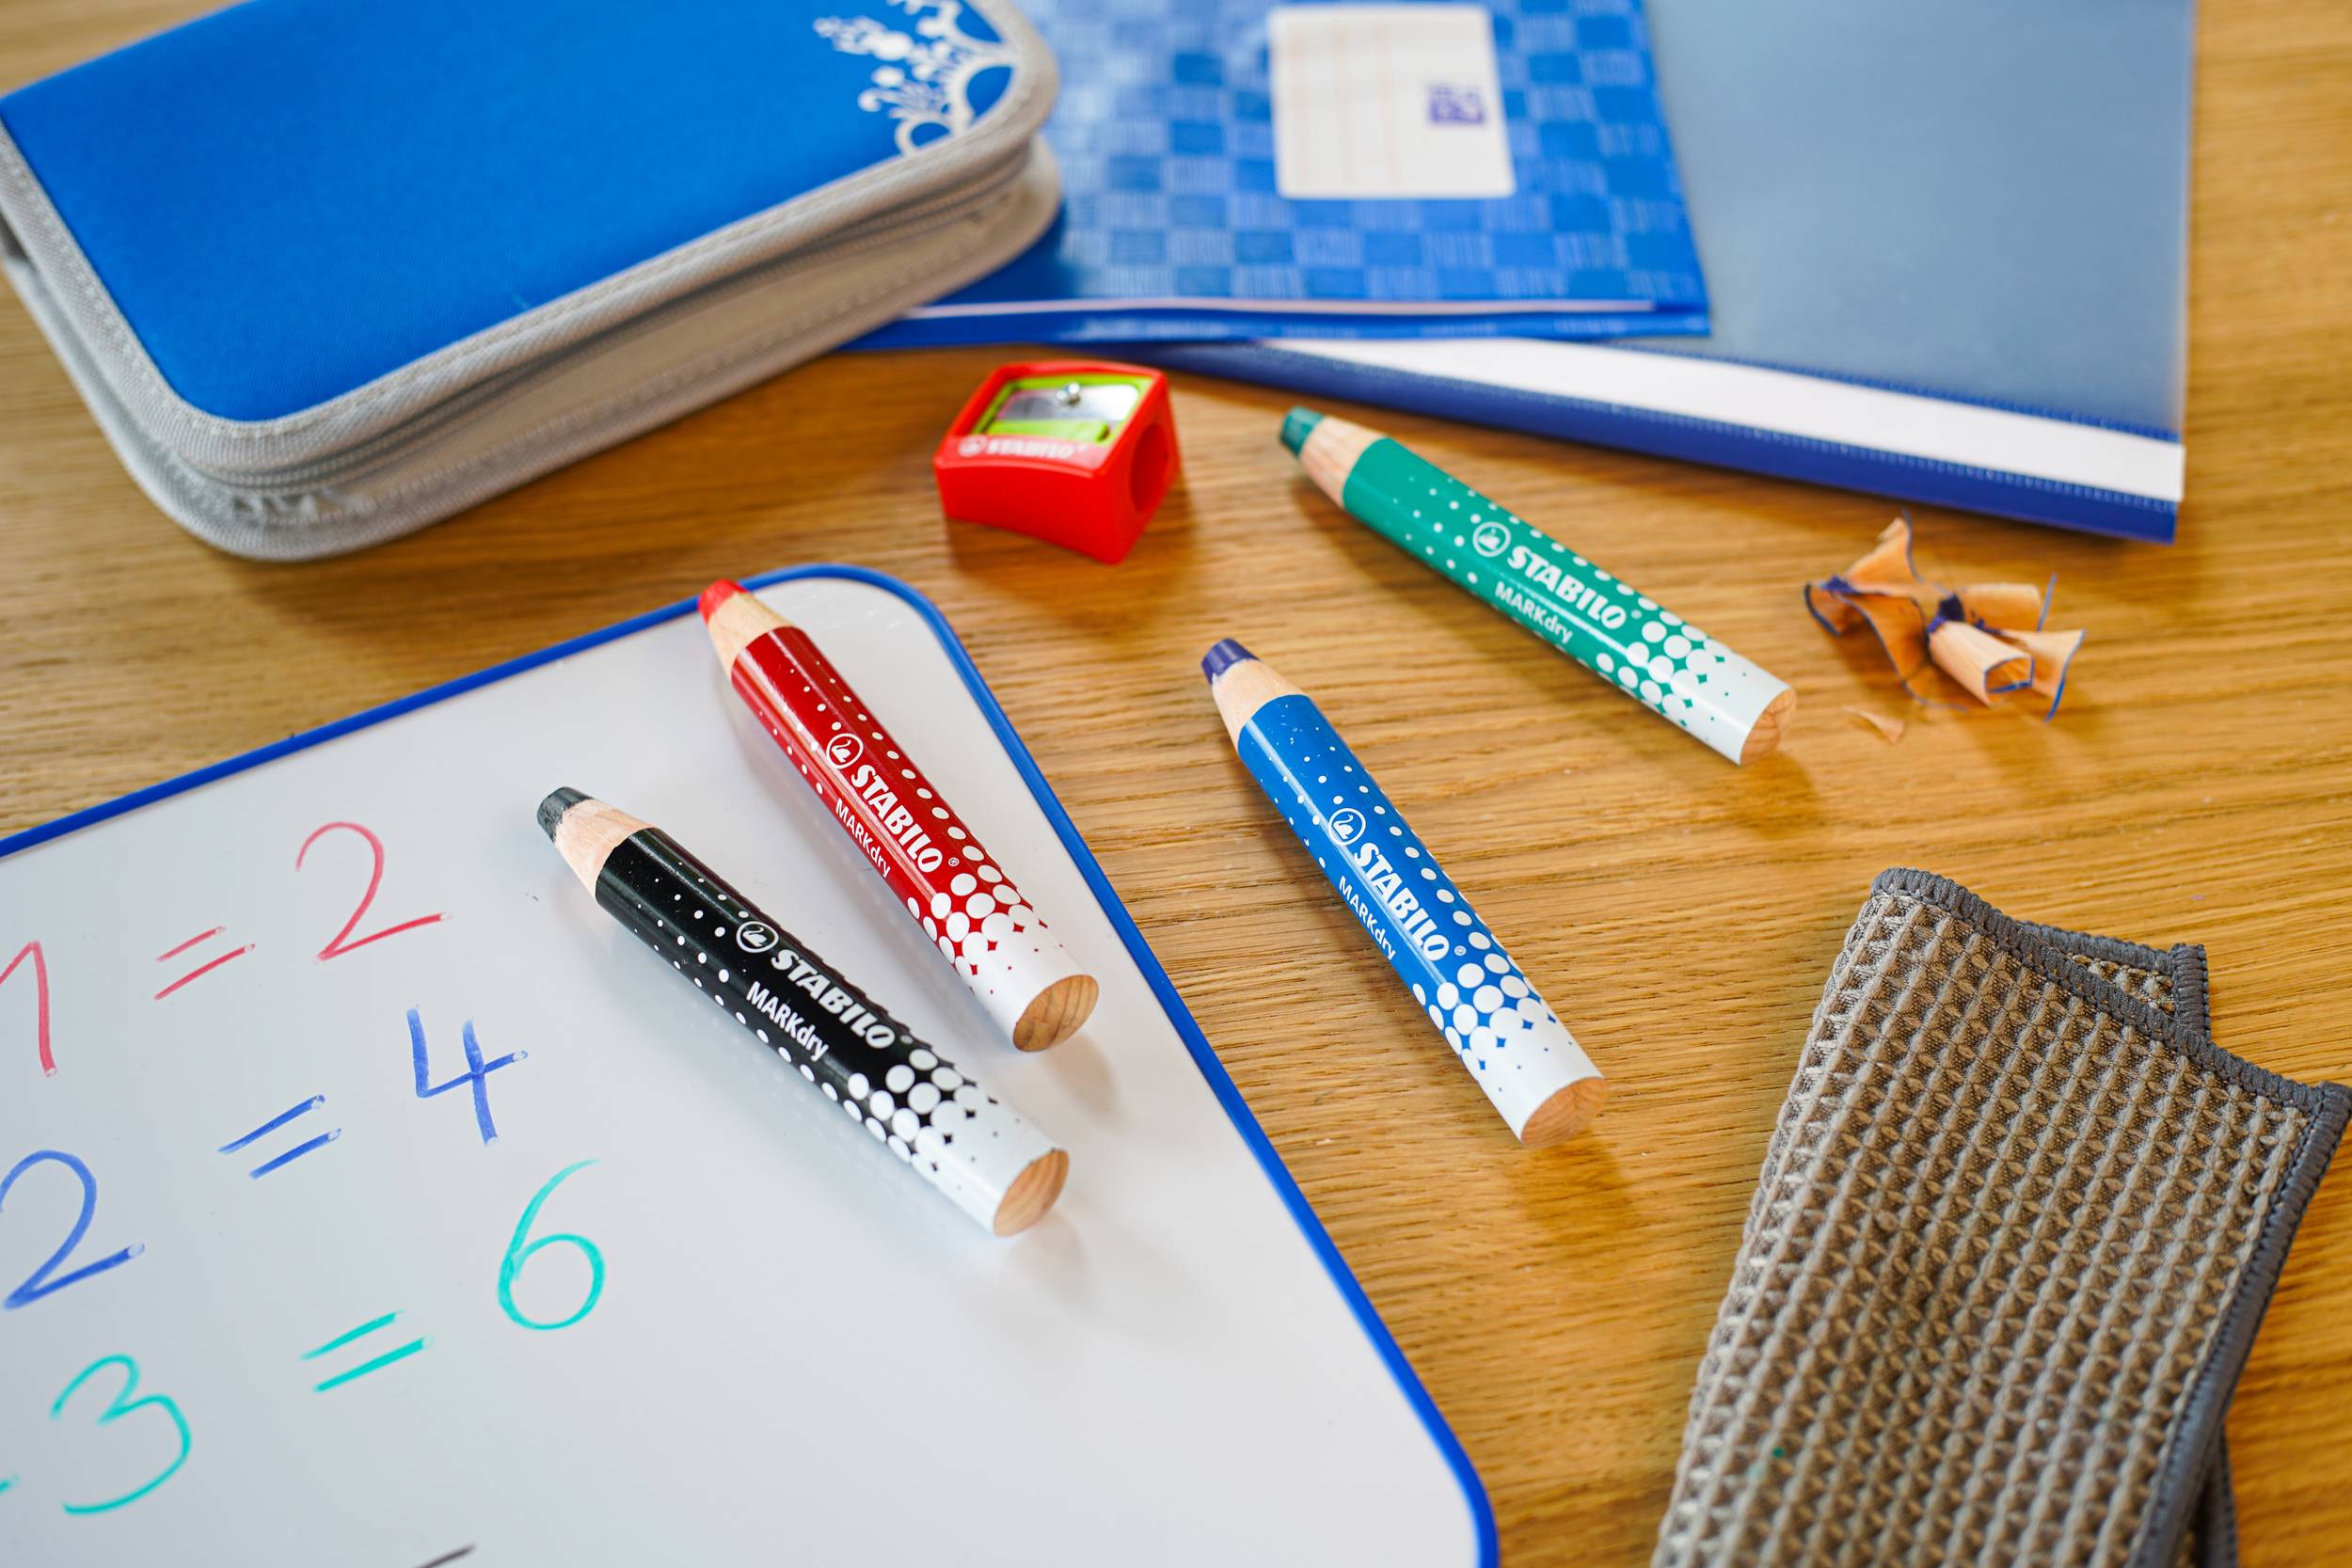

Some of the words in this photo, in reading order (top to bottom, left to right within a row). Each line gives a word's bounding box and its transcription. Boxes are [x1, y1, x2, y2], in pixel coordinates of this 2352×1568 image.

[1495, 581, 1573, 644] MARKdry
[1507, 546, 1626, 629] STABILO
[835, 798, 891, 879] MARKdry
[850, 764, 943, 873] STABILO
[297, 821, 453, 963] 2
[1339, 875, 1396, 960] MARKdry
[1354, 842, 1450, 961] STABILO
[746, 981, 829, 1062] MARKdry
[771, 949, 895, 1049] STABILO
[0, 1150, 145, 1310] 2
[406, 1005, 530, 1146] 4
[51, 1354, 191, 1515] 3
[498, 1159, 605, 1331] 6
